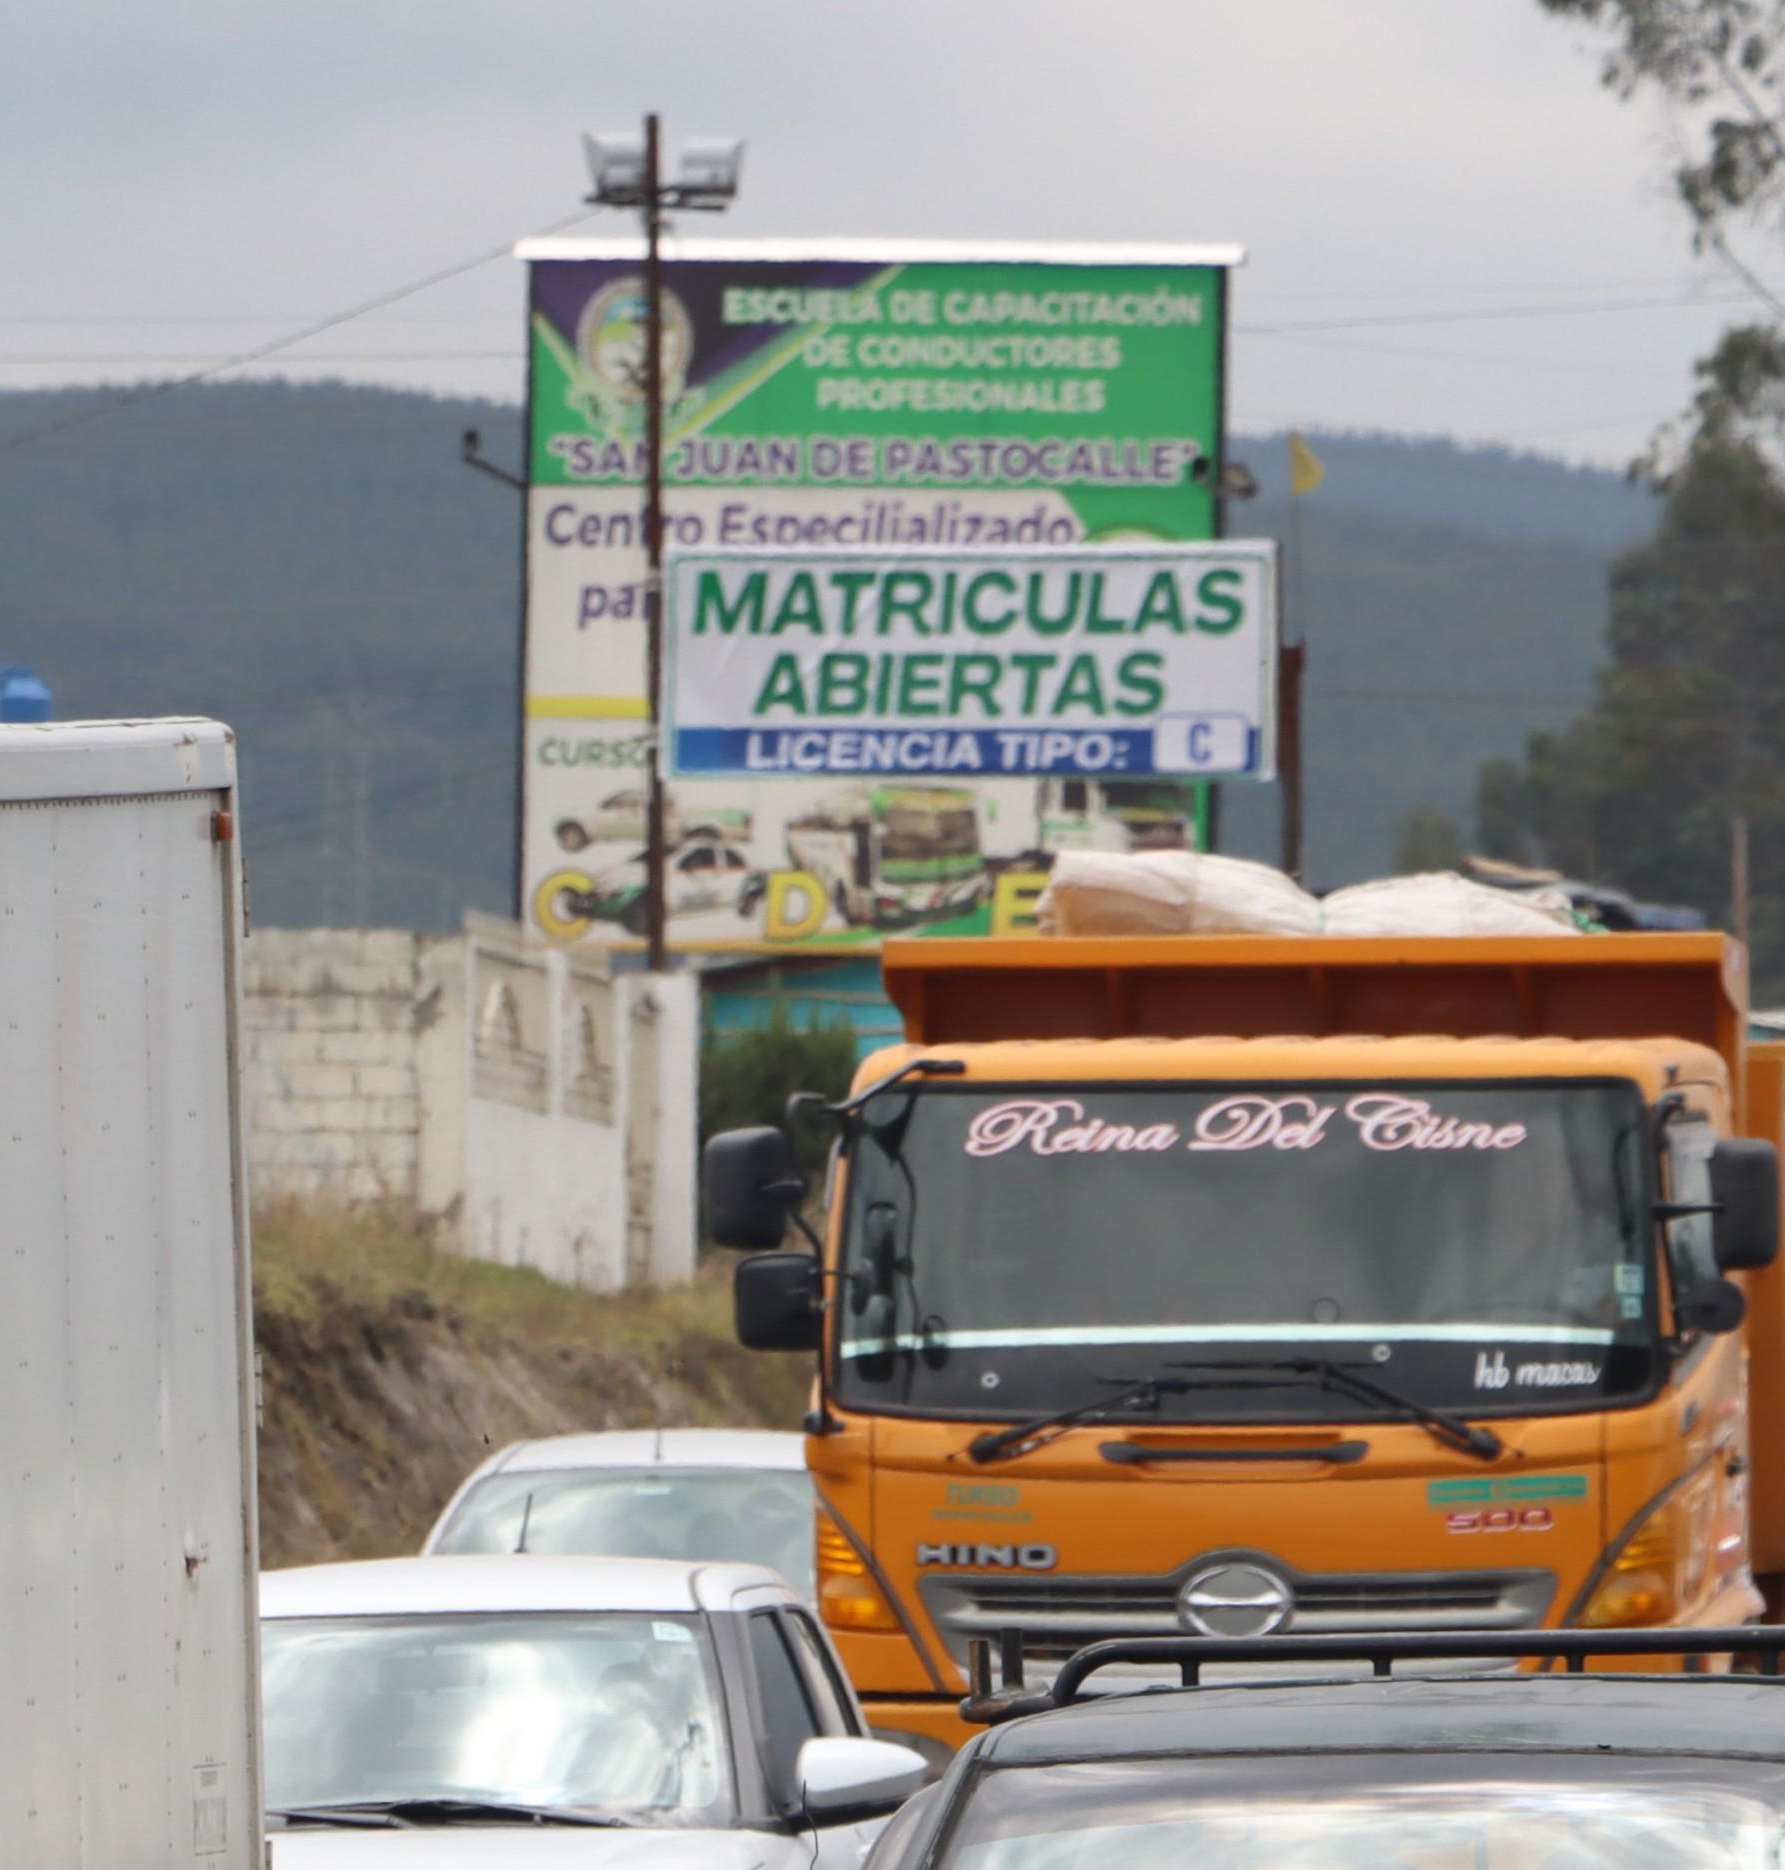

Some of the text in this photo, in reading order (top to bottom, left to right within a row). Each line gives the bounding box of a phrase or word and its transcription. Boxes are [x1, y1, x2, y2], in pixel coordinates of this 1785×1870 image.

[722, 282, 1202, 327] ESCUELA DE CAPACITACIÓN
[802, 334, 1123, 369] DE CONDUCTORES
[817, 377, 1107, 413] PROFESIONALES
[675, 438, 799, 478] JUAN
[810, 438, 872, 478] DE
[691, 568, 1245, 637] MATRICULAS
[752, 651, 1168, 717] ABIERTAS
[745, 721, 1213, 770] LICENCIA TIPO: C
[762, 870, 829, 942] D
[964, 1091, 1528, 1158] Reina Del Cisne
[917, 1542, 1059, 1571] HINO
